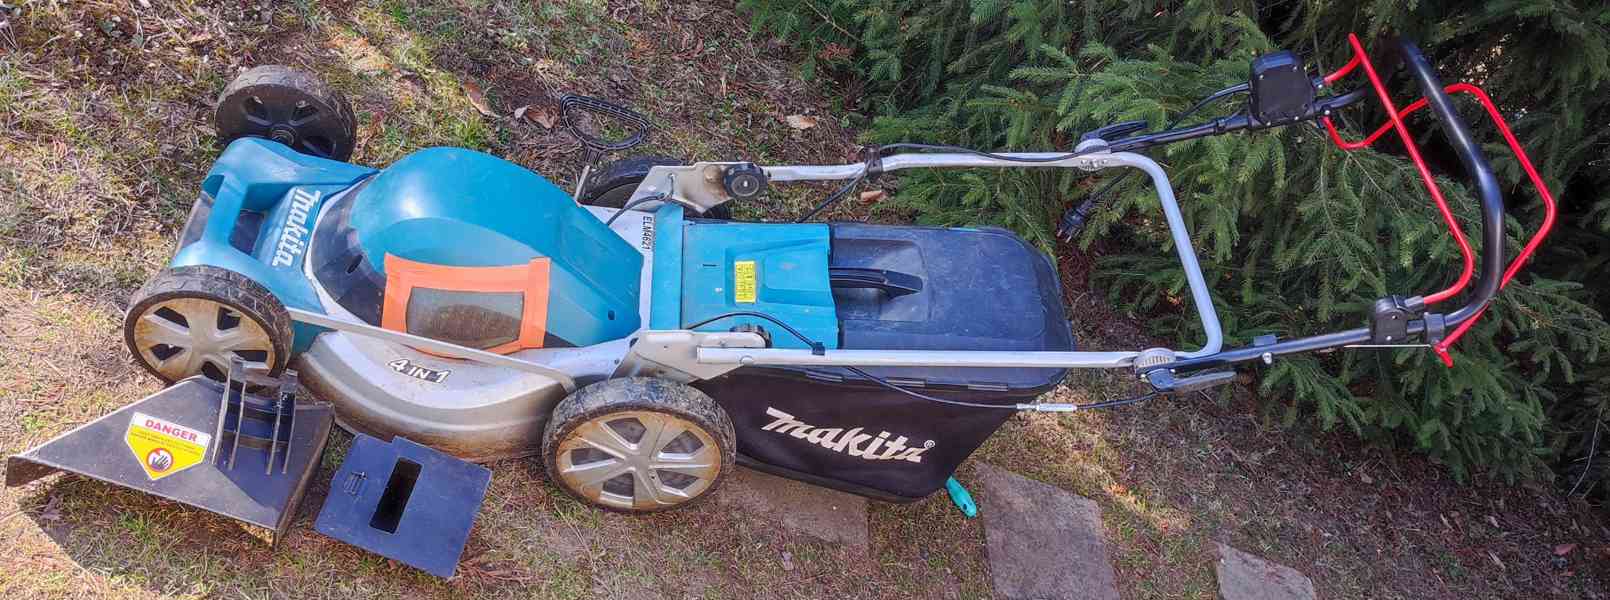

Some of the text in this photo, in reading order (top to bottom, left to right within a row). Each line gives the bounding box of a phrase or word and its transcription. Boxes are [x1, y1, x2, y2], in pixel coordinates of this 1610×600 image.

[641, 215, 653, 249] ELM4621
[389, 358, 451, 384] 4 IN 1
[145, 419, 198, 442] DANGER
